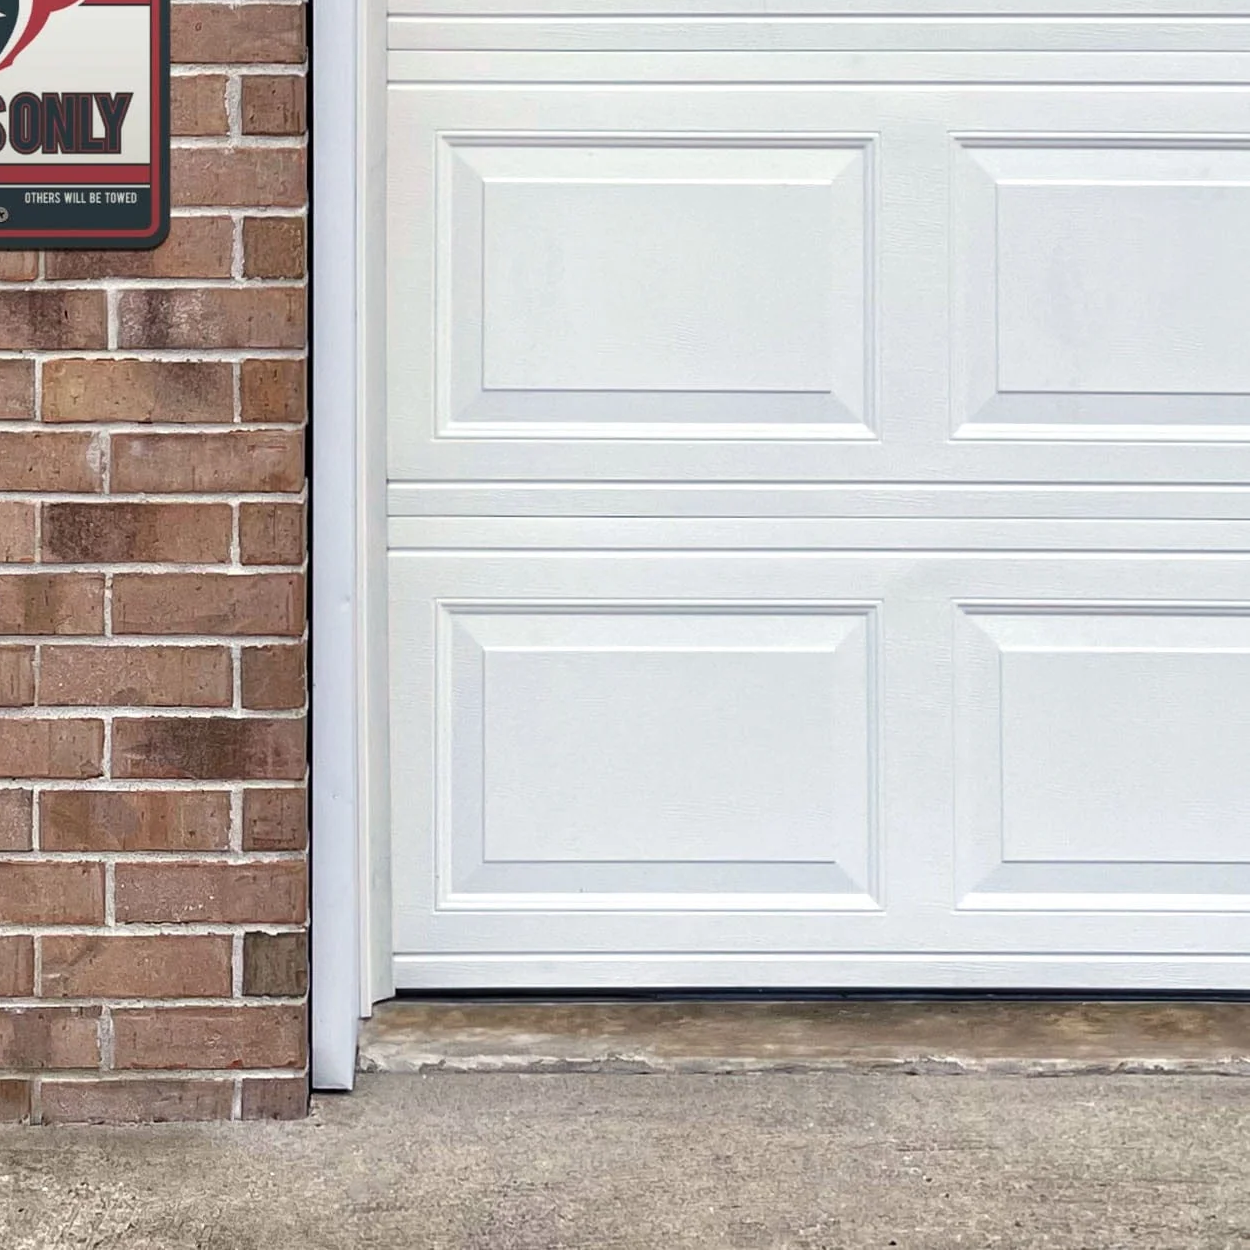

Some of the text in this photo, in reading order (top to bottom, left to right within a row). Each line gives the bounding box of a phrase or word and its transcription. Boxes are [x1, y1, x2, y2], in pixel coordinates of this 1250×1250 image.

[8, 92, 134, 154] ONLY
[24, 192, 138, 204] OTHERS WILL BE TOWED
